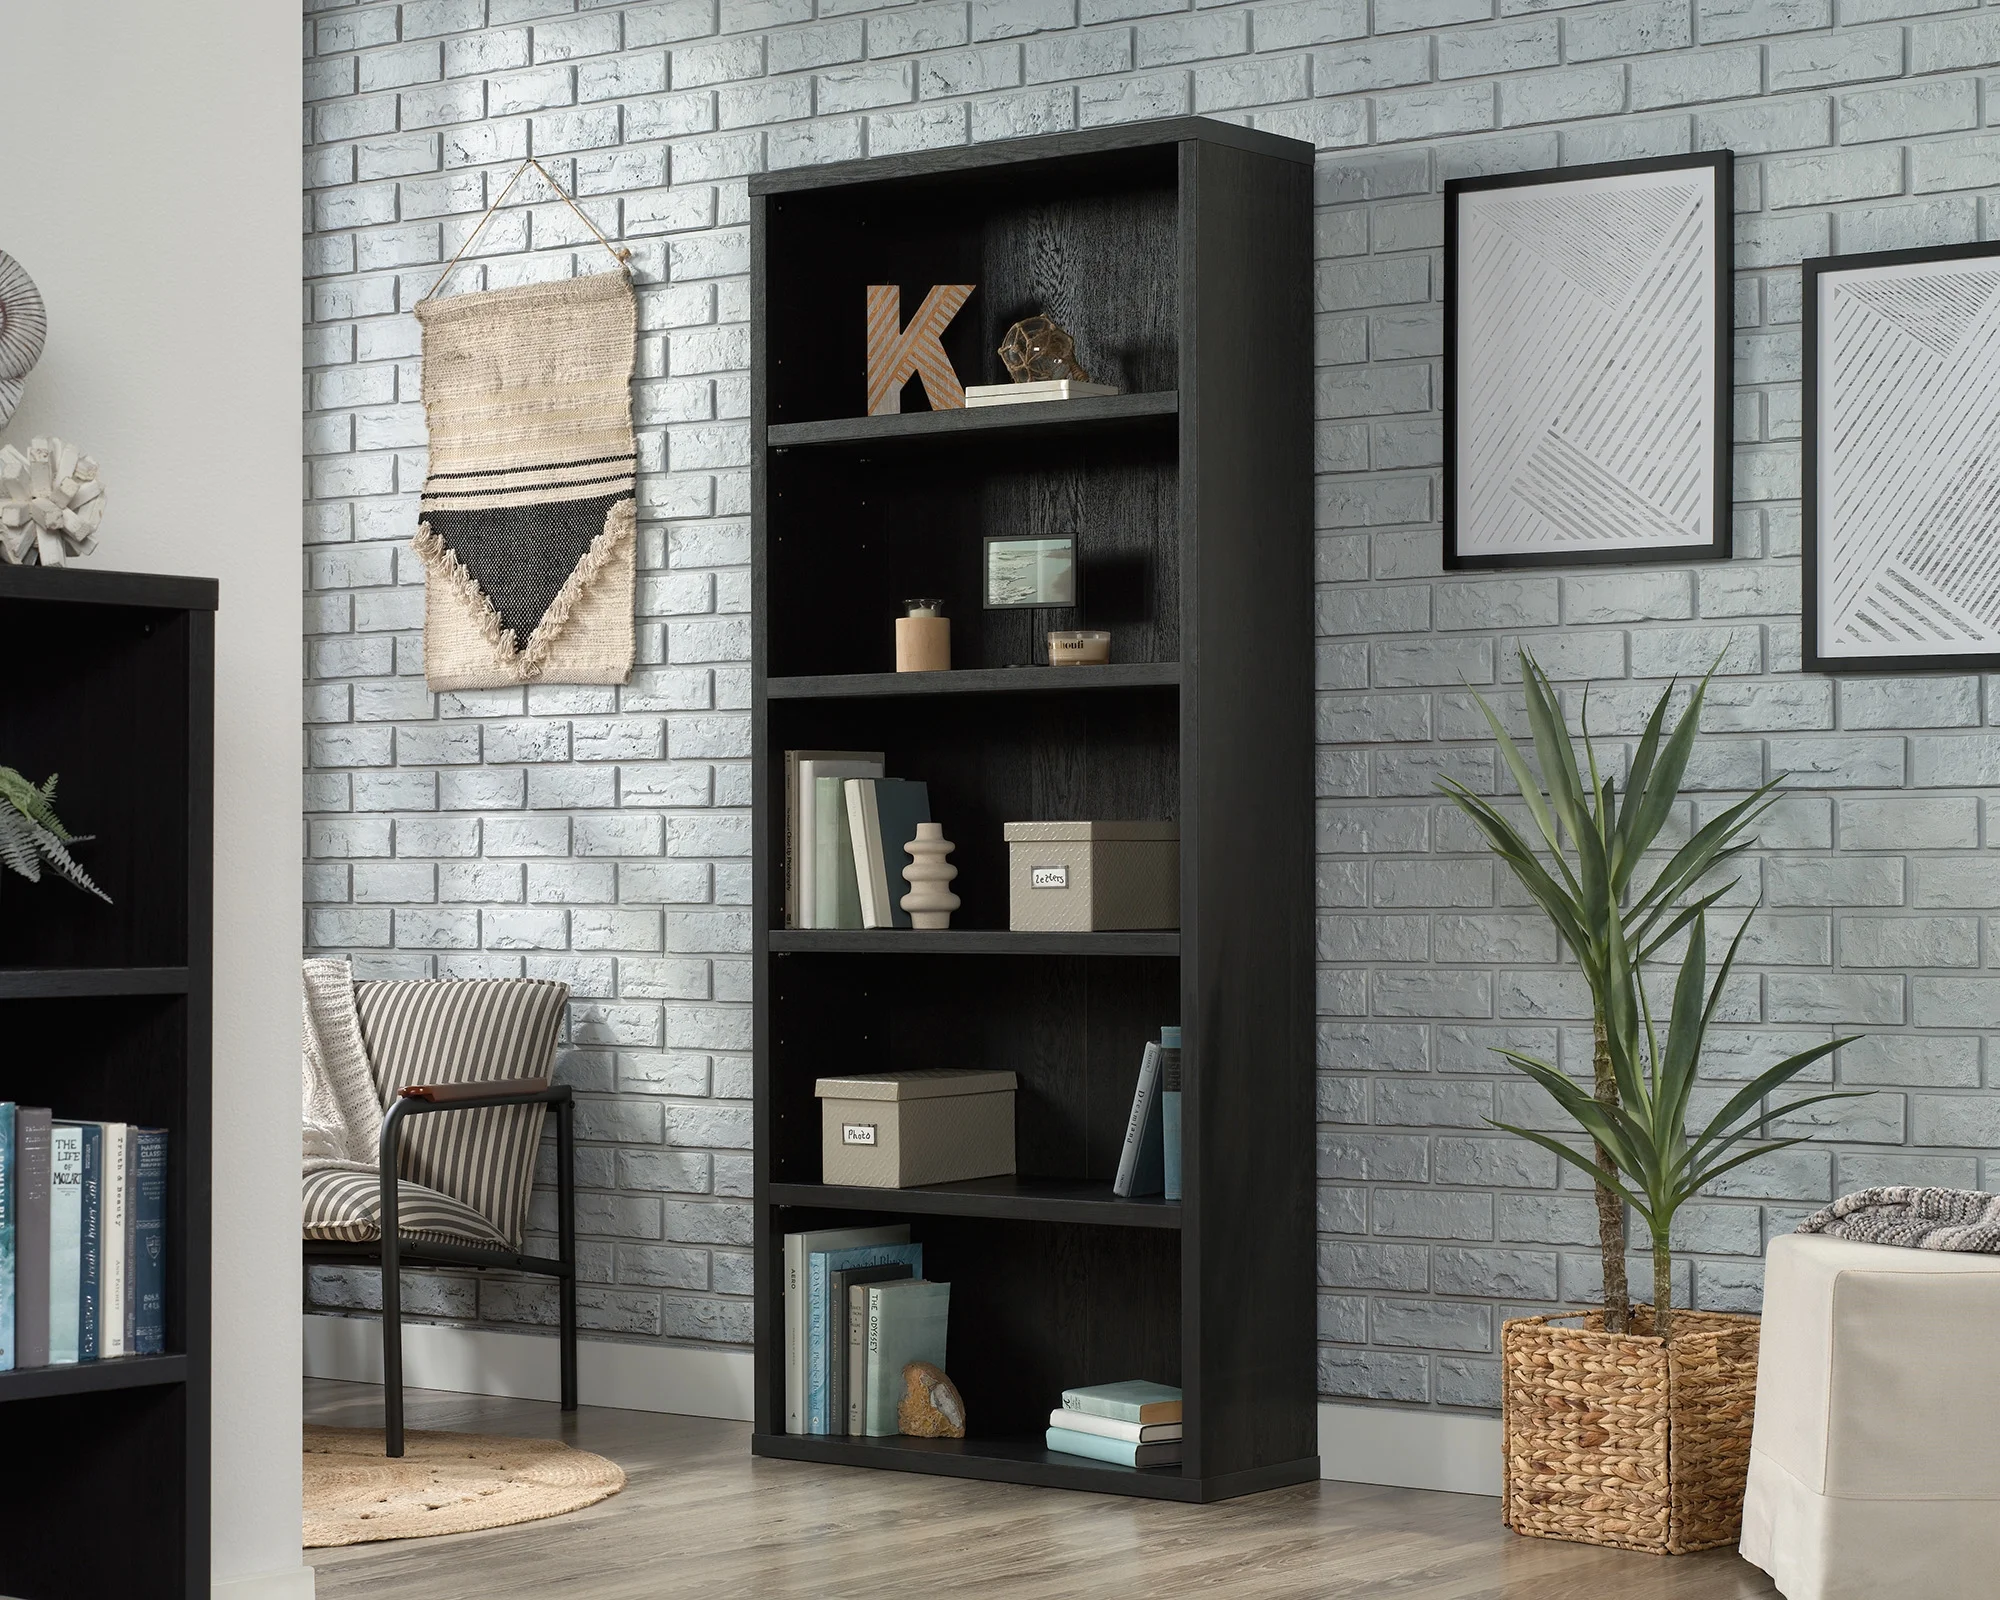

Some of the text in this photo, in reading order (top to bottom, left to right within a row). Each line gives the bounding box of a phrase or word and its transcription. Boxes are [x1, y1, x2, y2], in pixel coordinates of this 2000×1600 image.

[867, 284, 976, 416] K
[1126, 1090, 1146, 1144] Dreamland
[848, 1129, 871, 1140] Photo
[55, 1139, 77, 1150] THE
[57, 1151, 81, 1162] LIFE
[63, 1163, 73, 1171] OF
[53, 1172, 82, 1185] MOZART
[870, 1294, 879, 1354] THE ODYSSEY
[812, 1264, 820, 1411] COASTAL BLUES Phoebe Howard
